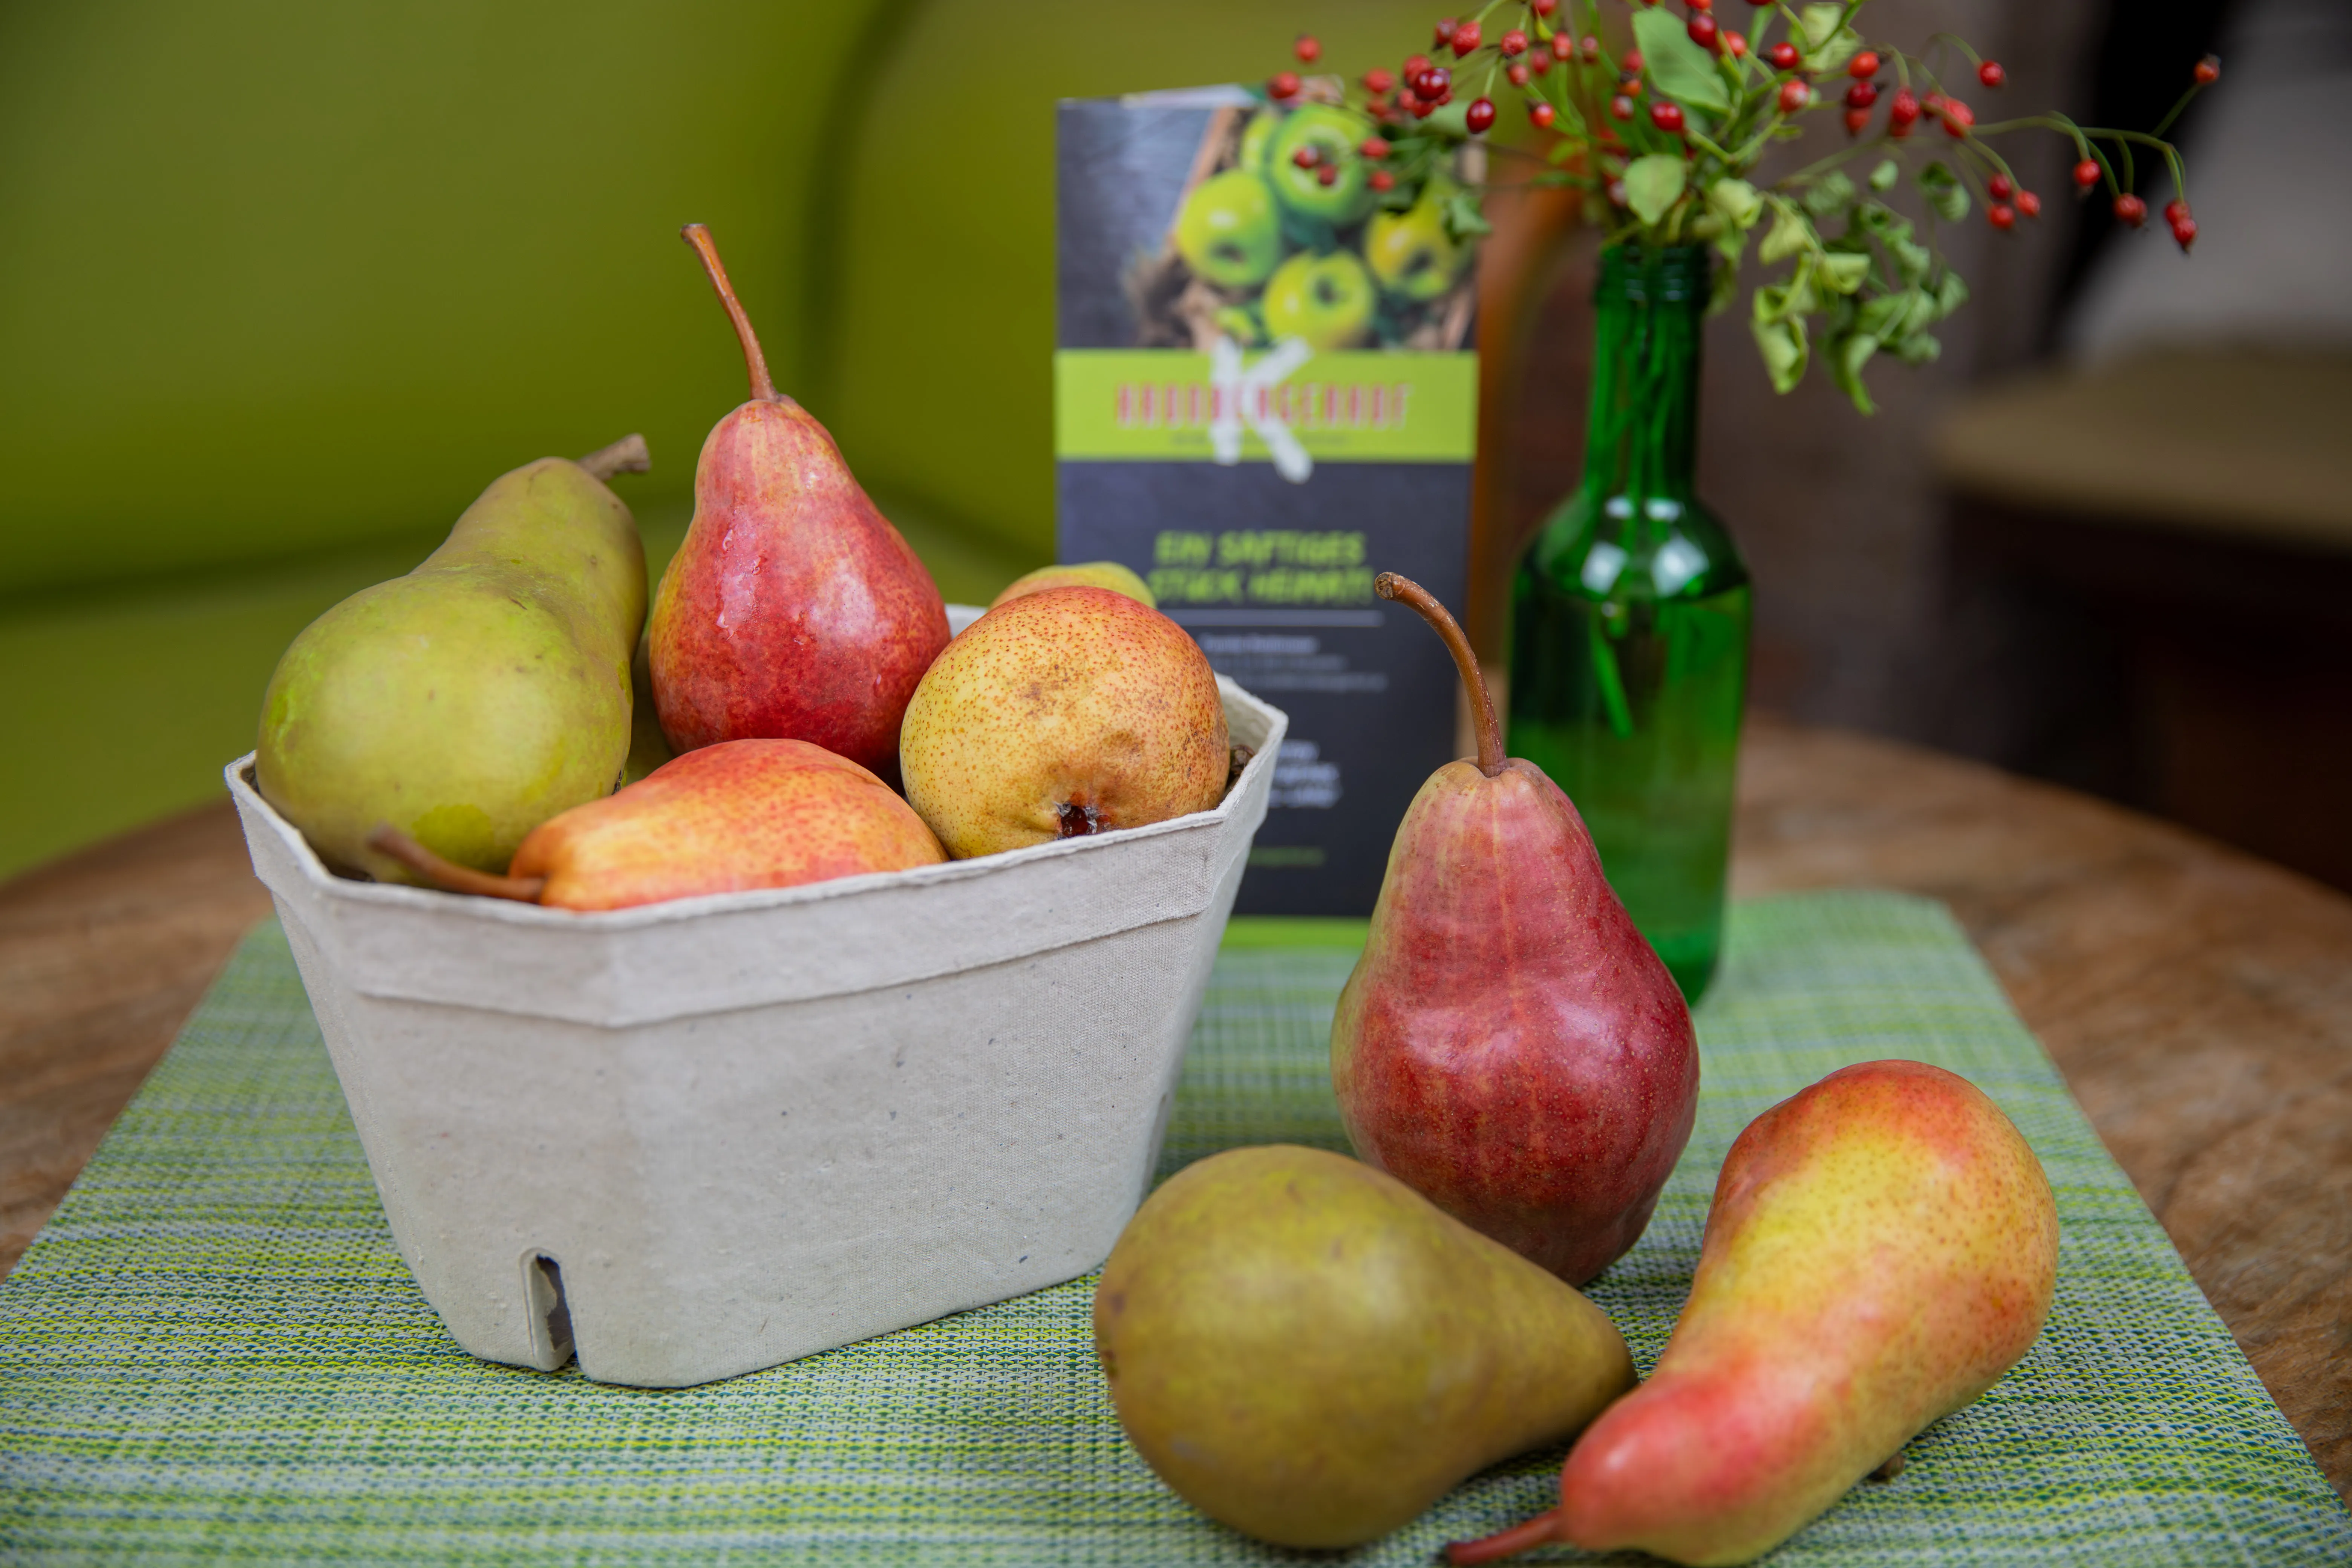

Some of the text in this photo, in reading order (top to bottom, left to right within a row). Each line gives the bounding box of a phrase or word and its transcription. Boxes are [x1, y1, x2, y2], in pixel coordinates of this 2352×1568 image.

[1210, 337, 1314, 484] K
[1155, 530, 1367, 566] EIN SAFTIGES
